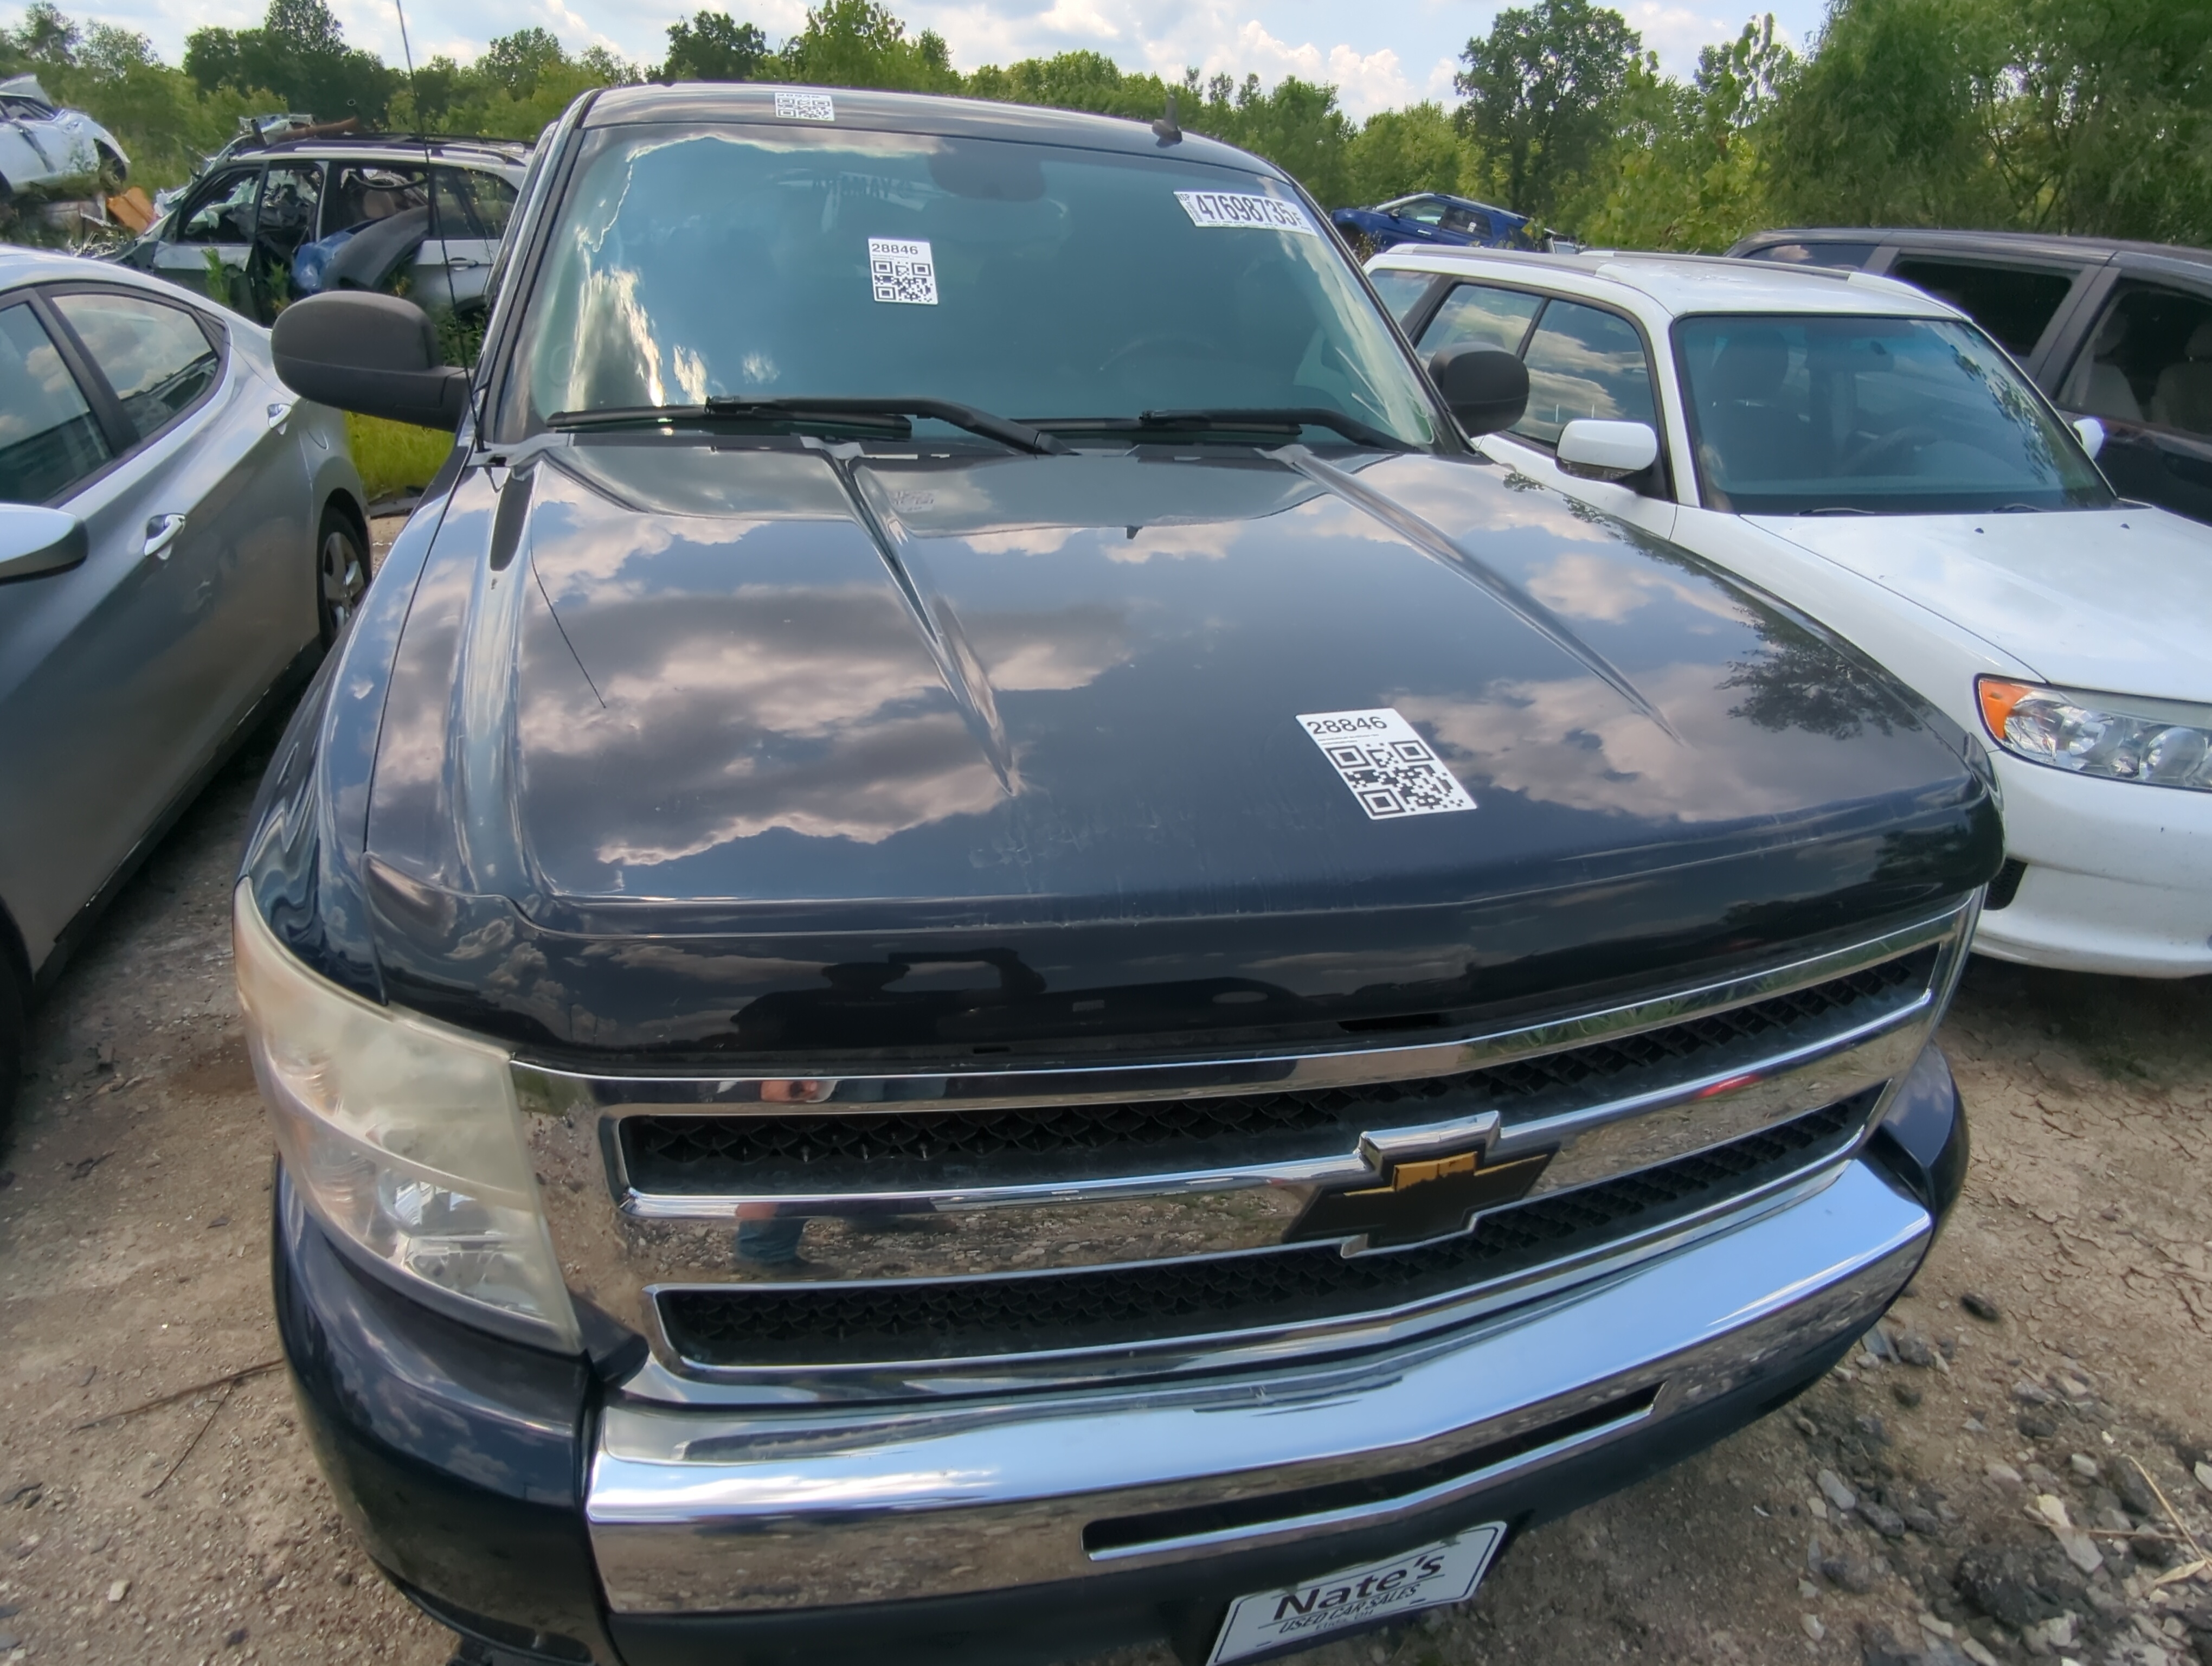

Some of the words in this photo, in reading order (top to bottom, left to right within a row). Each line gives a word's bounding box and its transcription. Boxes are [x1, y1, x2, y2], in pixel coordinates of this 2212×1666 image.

[1195, 194, 1297, 226] 47698735
[871, 244, 918, 255] 28846
[1307, 716, 1387, 735] 28846
[1273, 1555, 1445, 1620] Nate's
[1278, 1612, 1328, 1633] USED
[1330, 1601, 1366, 1619] CAR
[1365, 1584, 1420, 1609] SALES
